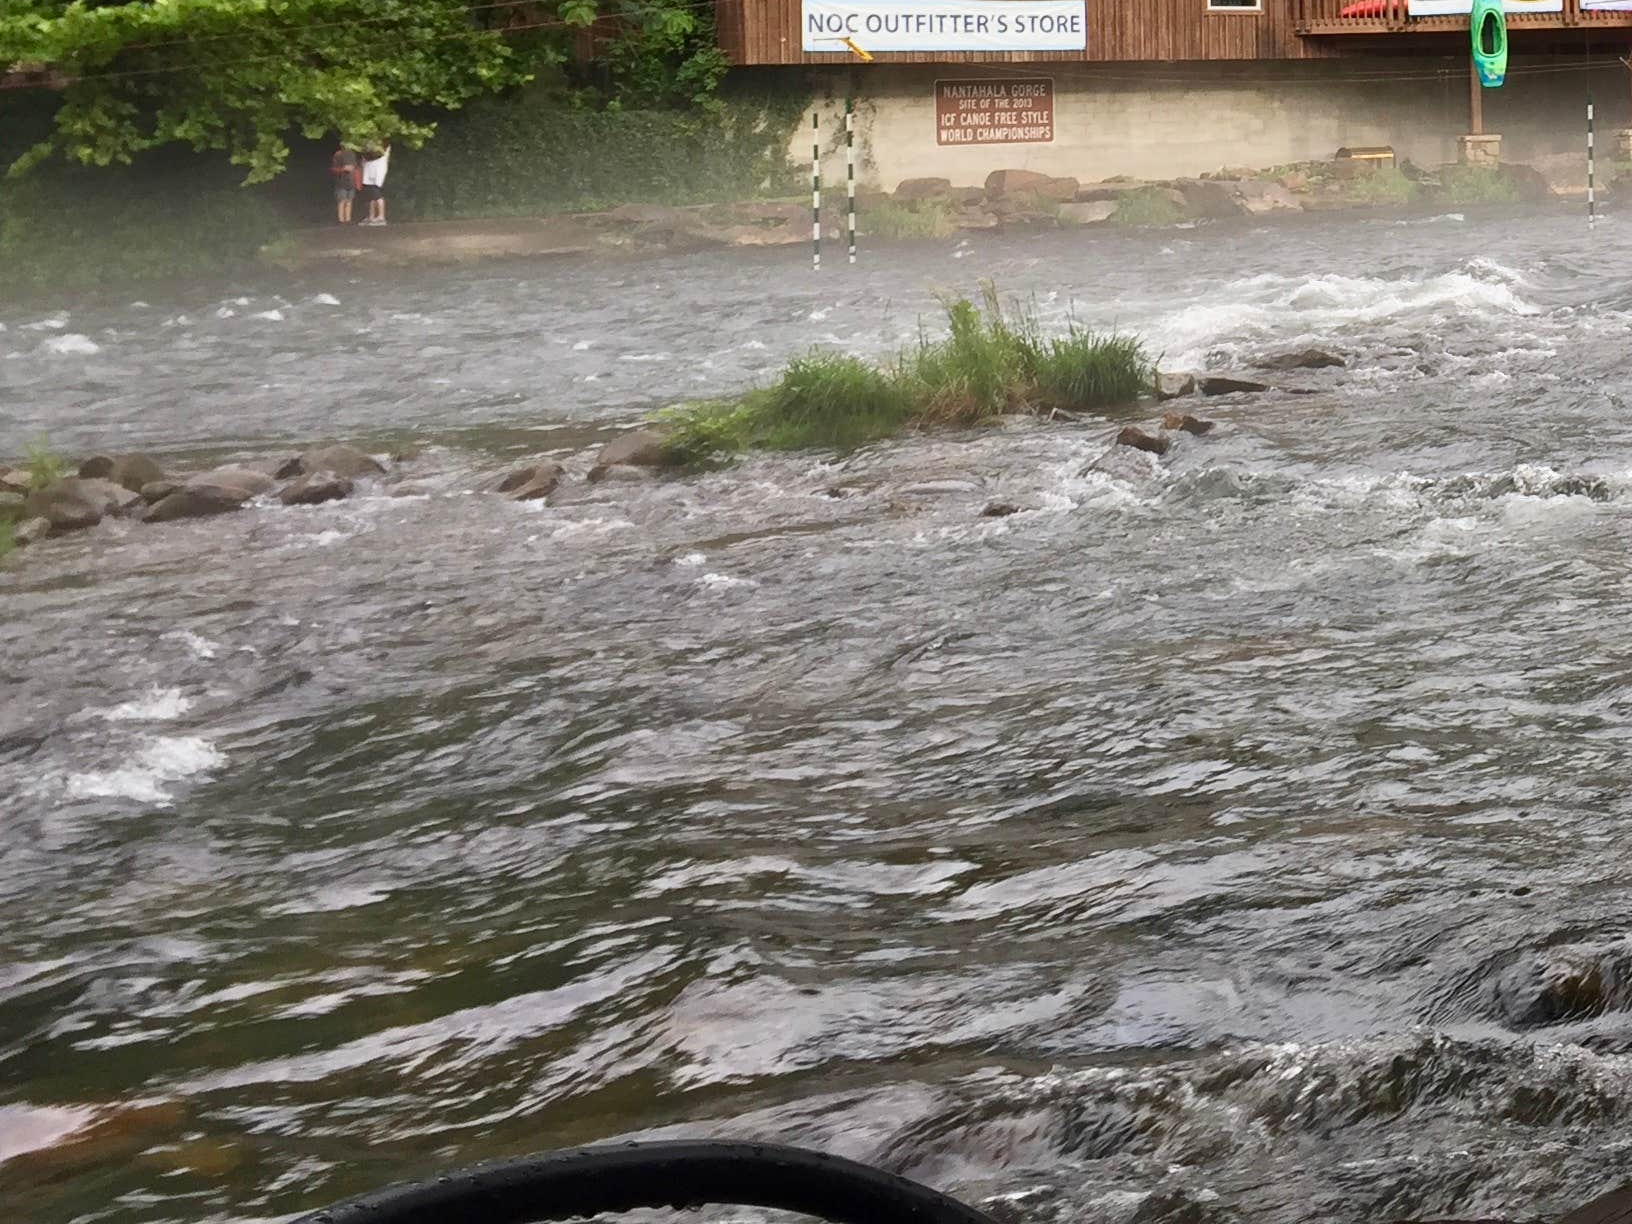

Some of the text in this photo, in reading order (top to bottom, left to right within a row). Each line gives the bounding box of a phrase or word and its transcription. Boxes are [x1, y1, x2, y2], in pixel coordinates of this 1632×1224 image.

[808, 14, 1080, 33] NOC OUTFITTER'S STORE
[943, 84, 1046, 97] NANTAHALA GORGE
[959, 98, 1032, 109] SITE OF THE 2013
[941, 111, 1049, 126] ICF CANOE FREE STYLE
[940, 126, 1051, 142] WORLD CHAMPIONSHIPS
